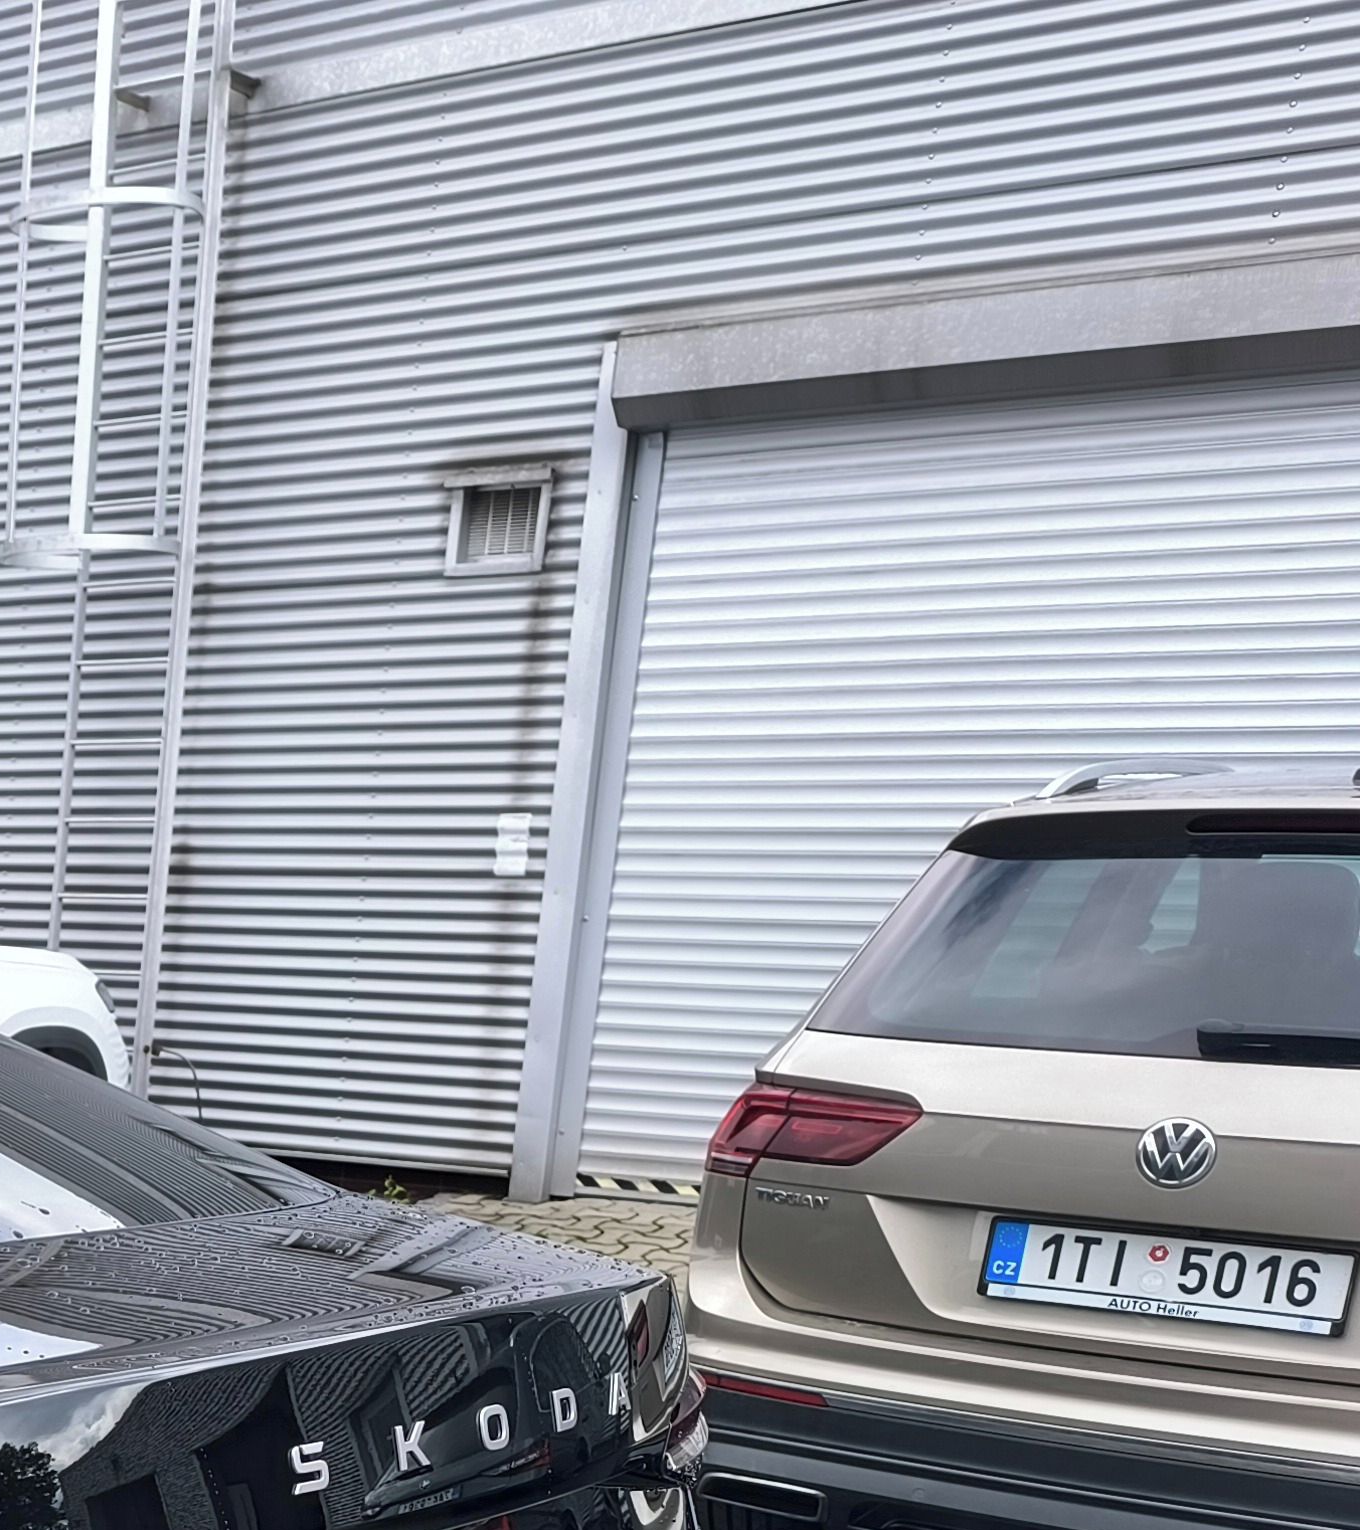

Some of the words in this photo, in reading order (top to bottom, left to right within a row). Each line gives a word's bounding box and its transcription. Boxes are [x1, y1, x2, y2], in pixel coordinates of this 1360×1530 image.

[992, 1260, 1018, 1276] CZ
[1041, 1233, 1128, 1288] 1TI
[1177, 1246, 1322, 1308] 5016
[1108, 1297, 1152, 1314] AUTO
[1156, 1303, 1200, 1319] Heller
